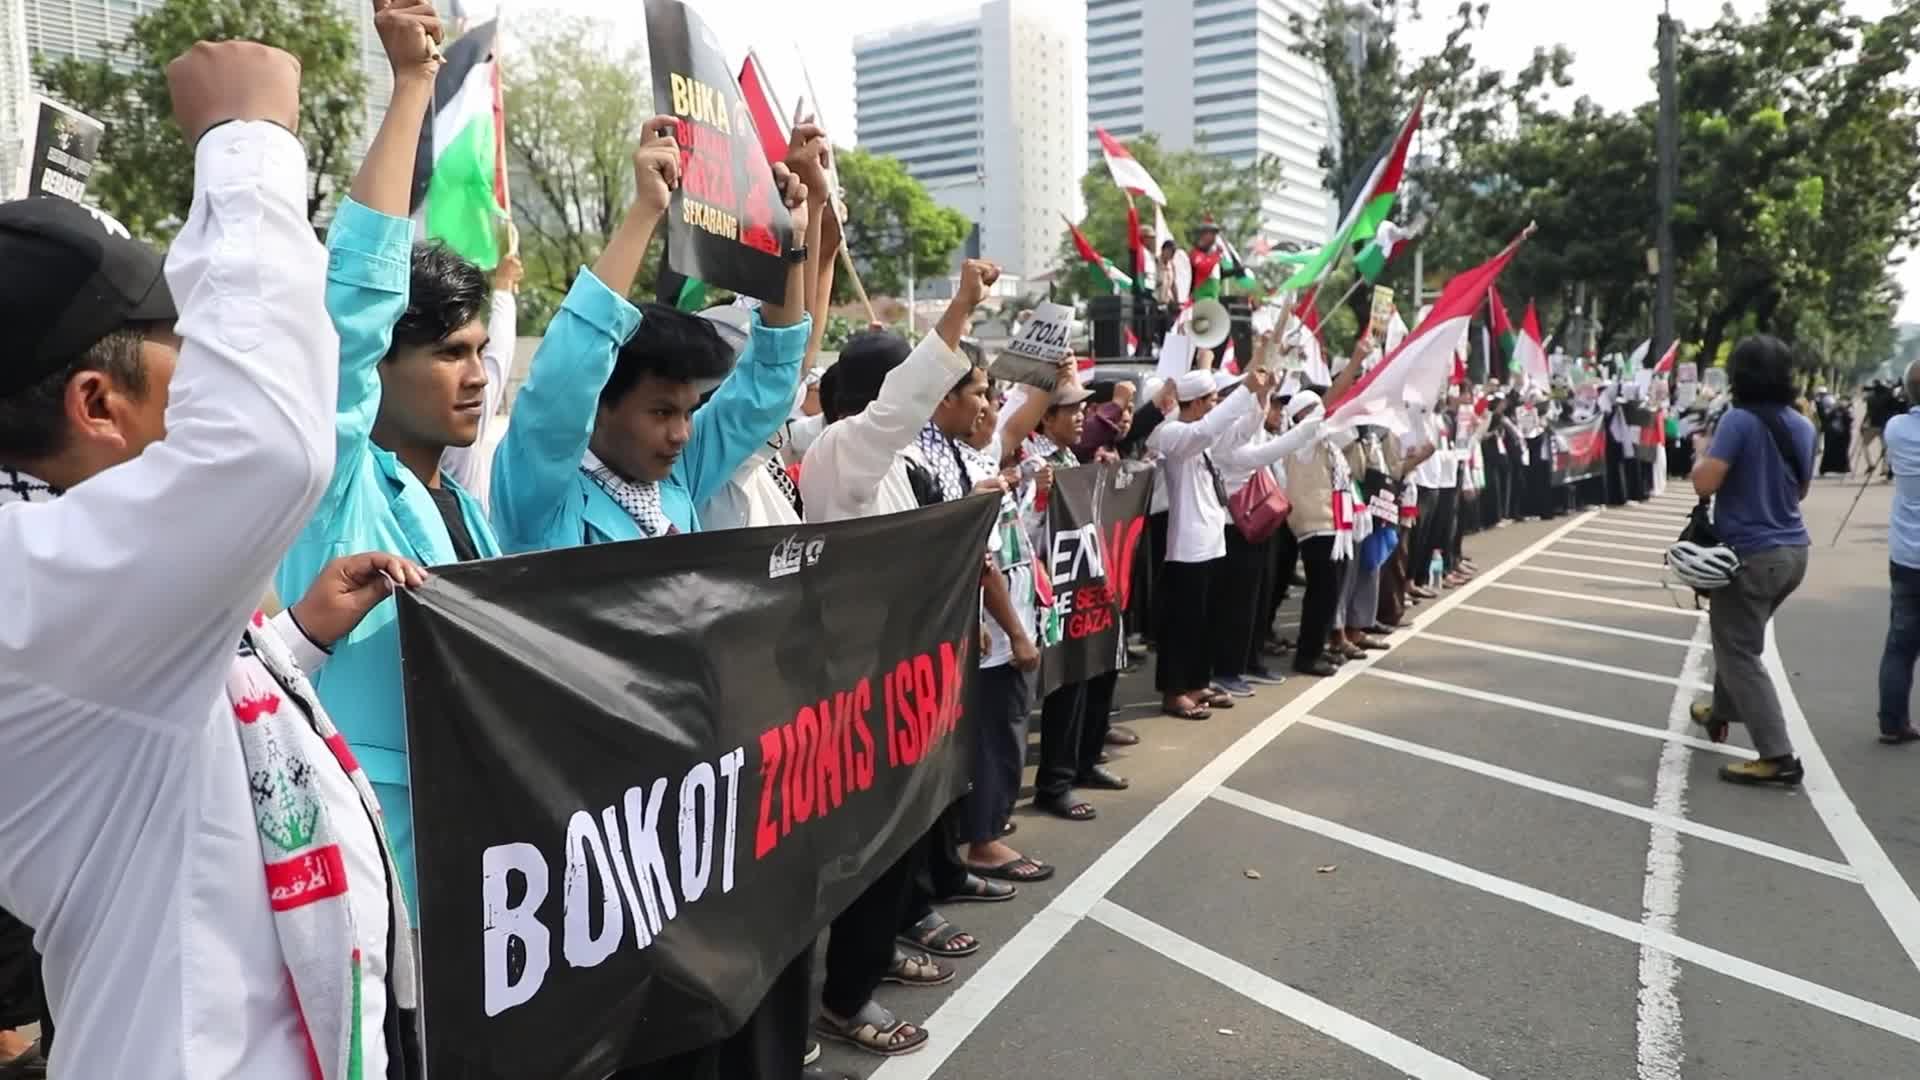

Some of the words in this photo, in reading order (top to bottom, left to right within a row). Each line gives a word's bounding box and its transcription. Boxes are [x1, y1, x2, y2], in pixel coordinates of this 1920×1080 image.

[670, 72, 732, 135] BUKA
[682, 197, 737, 241] SEKARANG
[1025, 320, 1069, 348] TOLA
[1069, 607, 1113, 639] GAZA
[483, 746, 744, 1017] BOIKOT
[756, 676, 875, 860] ZIONIS
